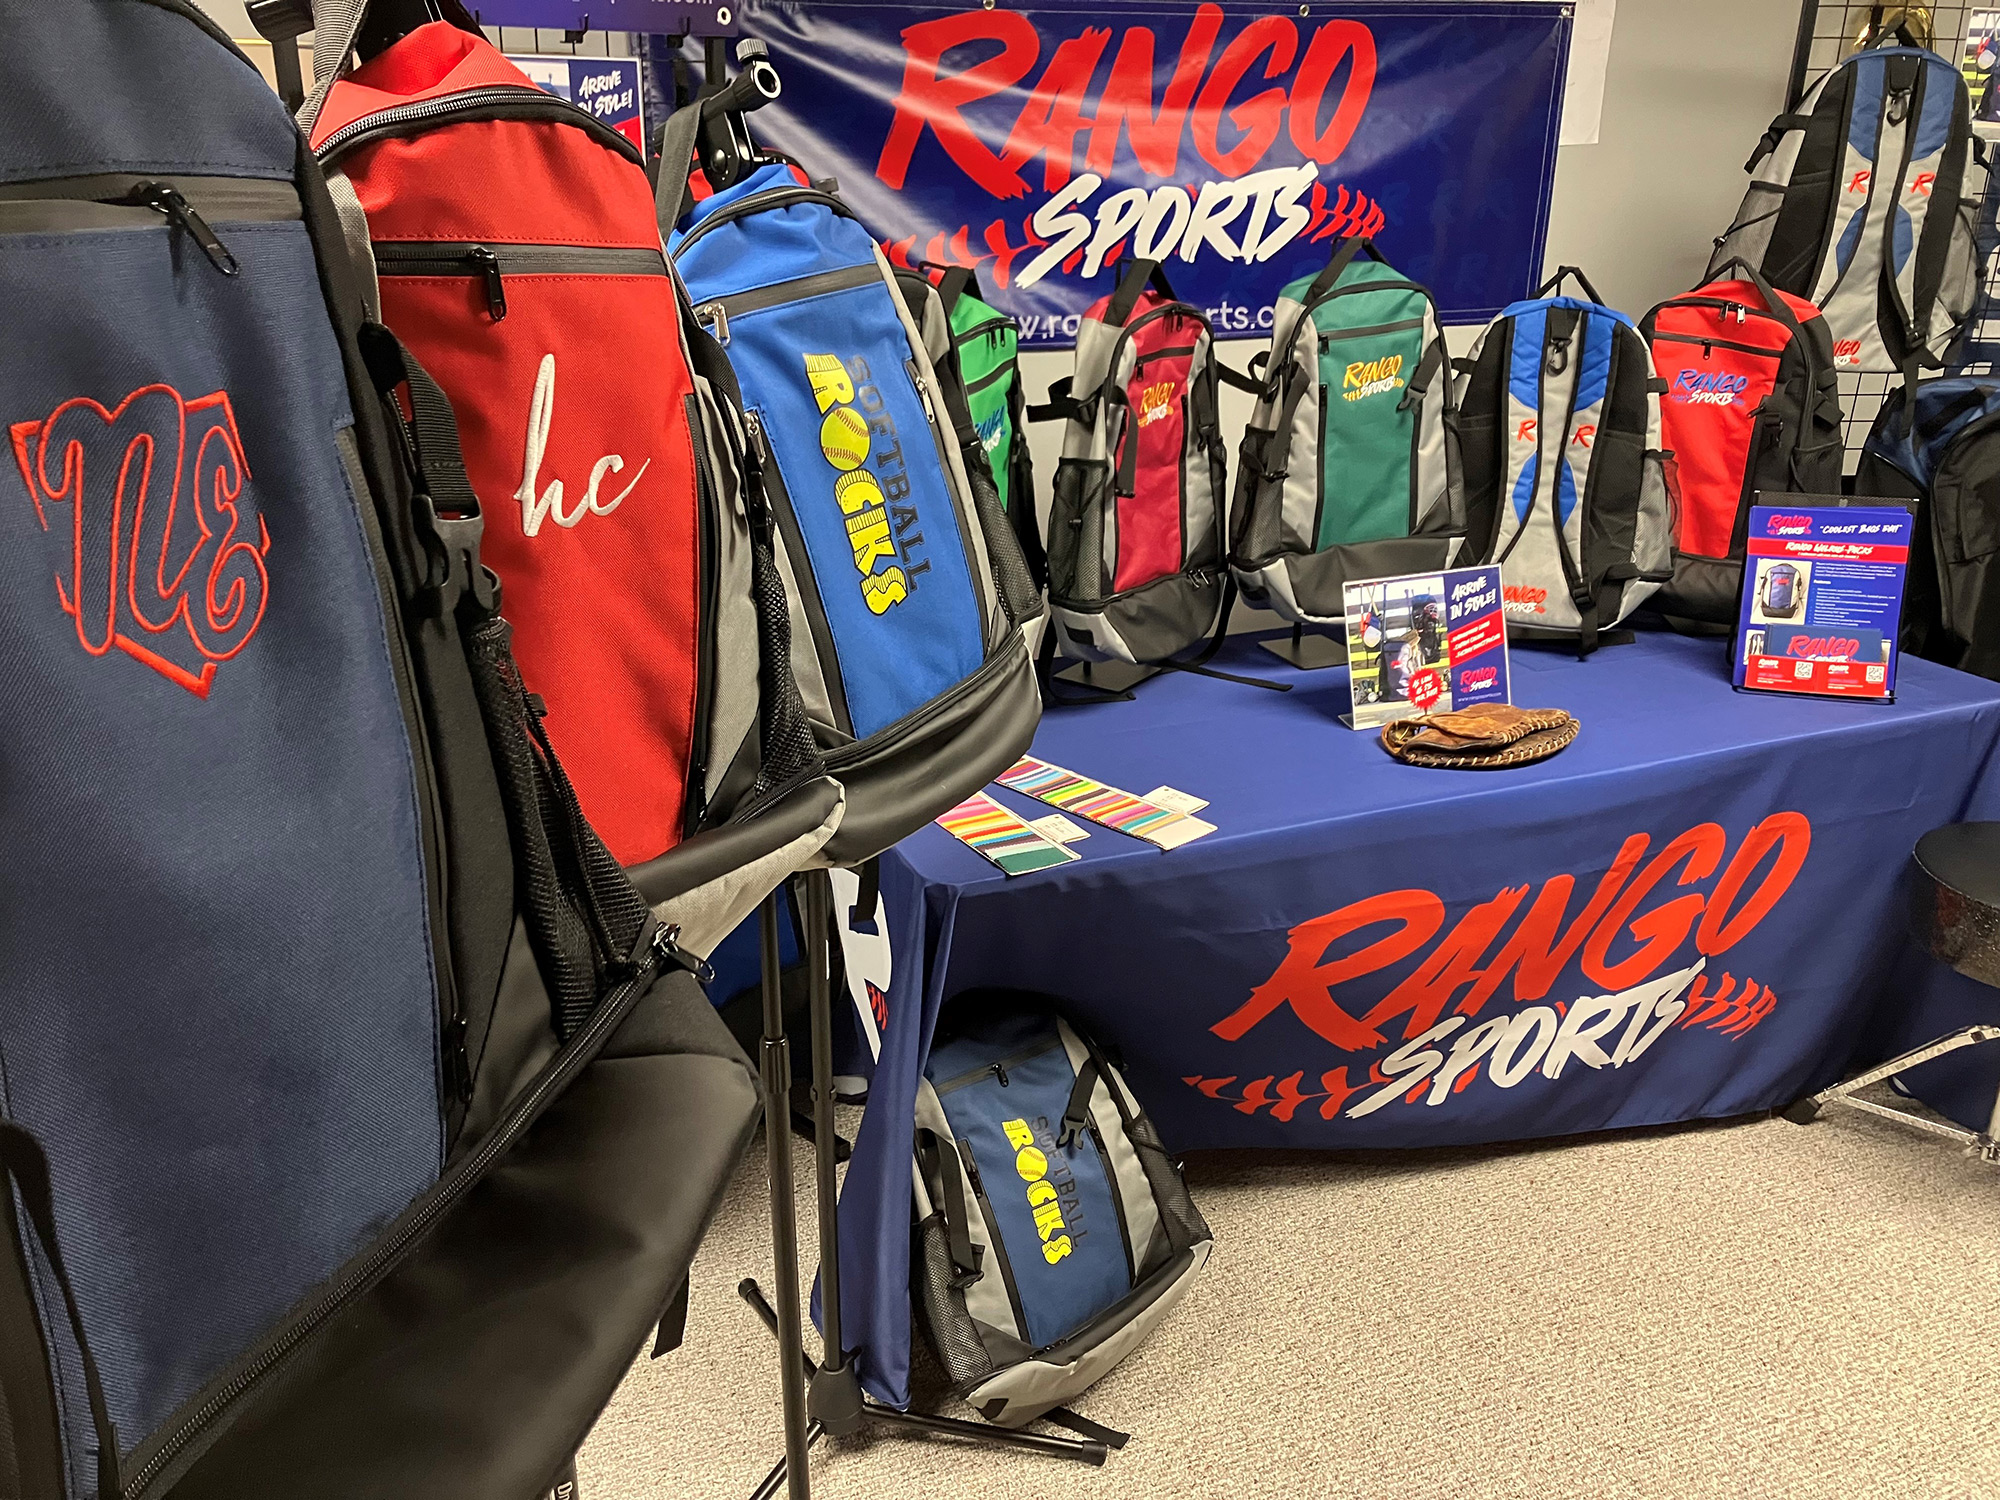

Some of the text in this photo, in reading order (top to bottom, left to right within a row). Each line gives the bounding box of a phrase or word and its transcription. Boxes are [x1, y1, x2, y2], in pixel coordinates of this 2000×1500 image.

[579, 70, 621, 99] ARRIVE
[595, 88, 633, 118] STYLE!
[876, 4, 1377, 200] RANGO
[1848, 170, 1870, 194] R
[1910, 171, 1936, 196] R
[1016, 161, 1319, 288] SPORTS
[1833, 338, 1861, 356] NGO
[1343, 355, 1402, 389] RANGO
[1674, 369, 1748, 394] RANGO
[1688, 389, 1735, 406] SPORTS
[1517, 418, 1537, 442] R
[1572, 423, 1595, 448] R
[513, 353, 651, 538] hc
[803, 353, 909, 616] ROCKS
[844, 354, 932, 593] SOFTBALL
[1451, 576, 1487, 602] ARRIVE
[1450, 588, 1497, 620] IN STYLE!
[1786, 635, 1859, 657] RANGO
[1460, 667, 1497, 686] RANGO
[1209, 811, 1811, 1052] RANGO
[1345, 957, 1706, 1118] SPORTS
[1001, 1118, 1073, 1265] ROCKS
